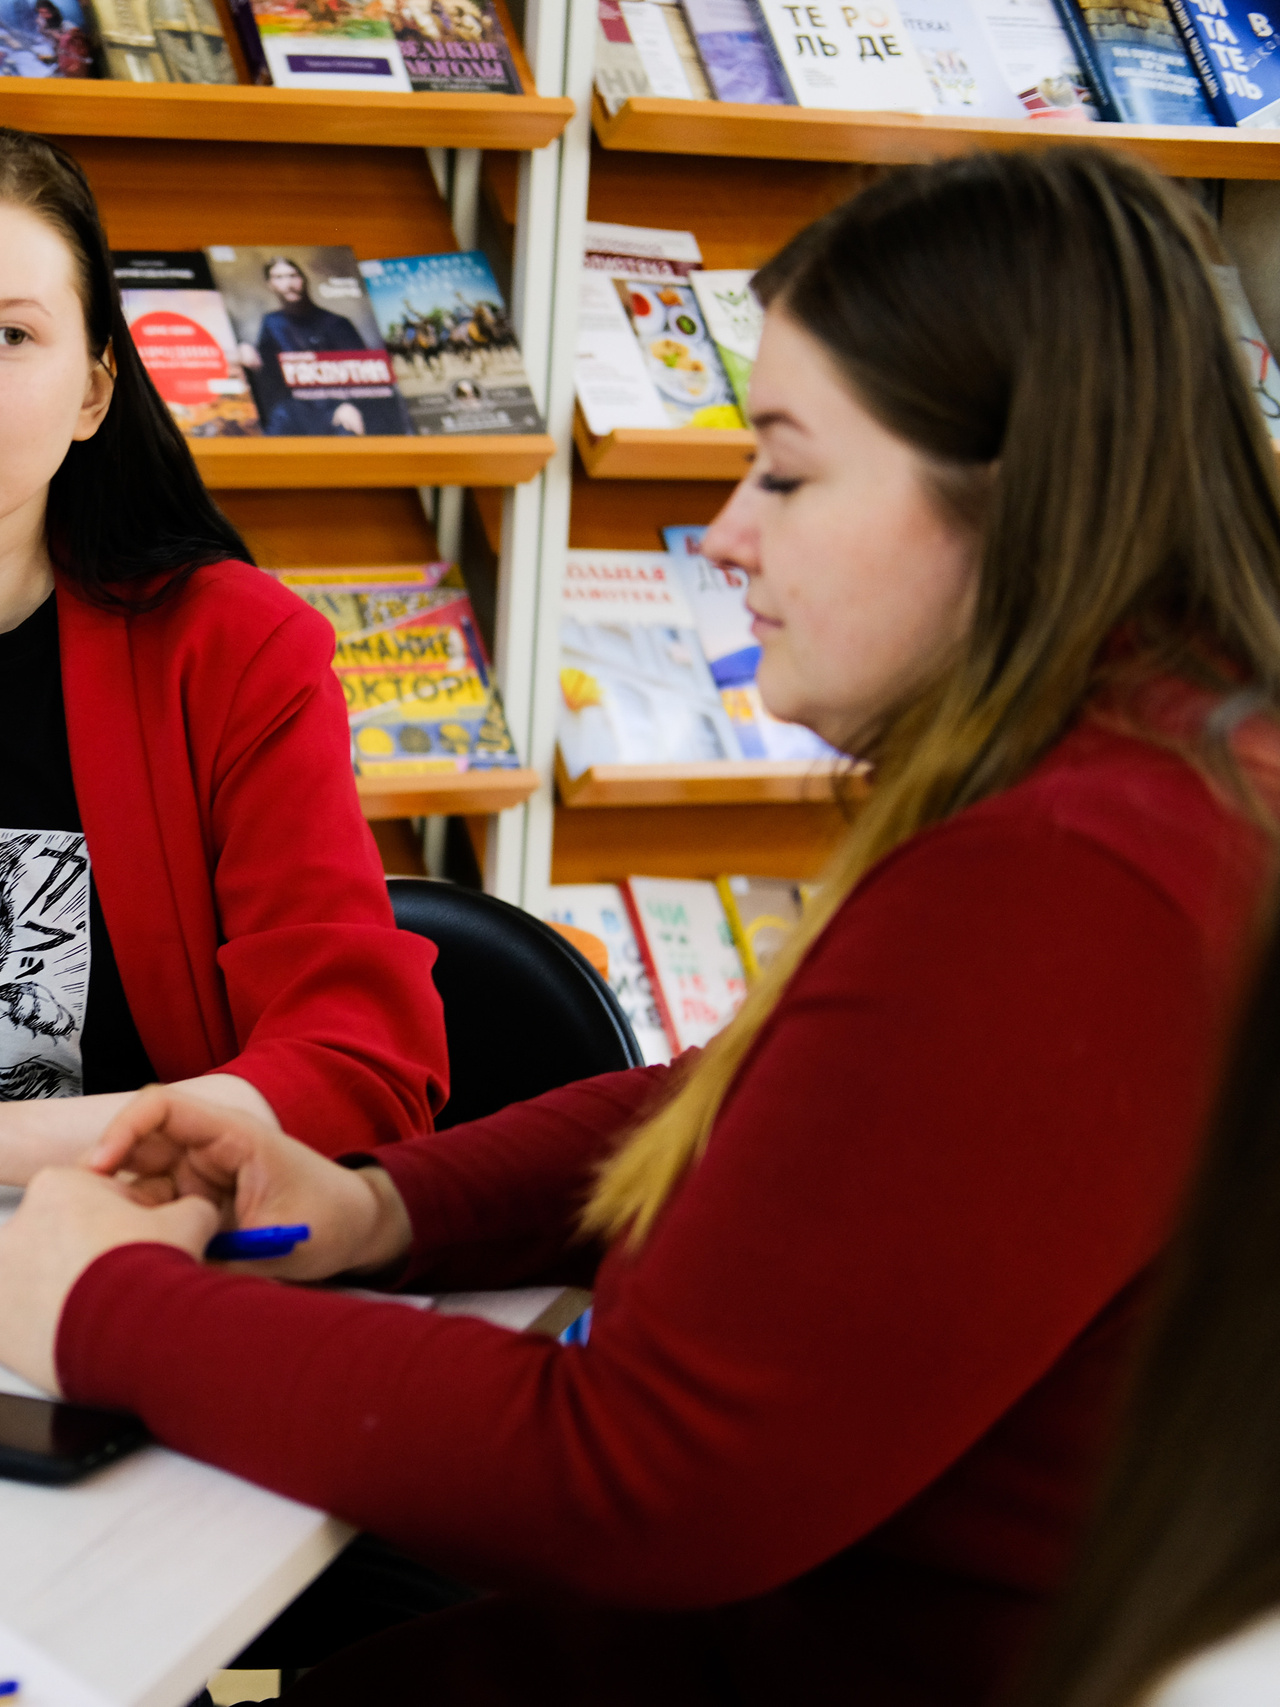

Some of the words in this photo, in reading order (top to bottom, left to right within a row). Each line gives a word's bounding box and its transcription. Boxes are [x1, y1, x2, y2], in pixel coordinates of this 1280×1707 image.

[1195, 14, 1239, 44] ТА
[1247, 12, 1274, 37] В
[1208, 42, 1250, 72] ТЕ
[1221, 71, 1264, 100] ЛЬ
